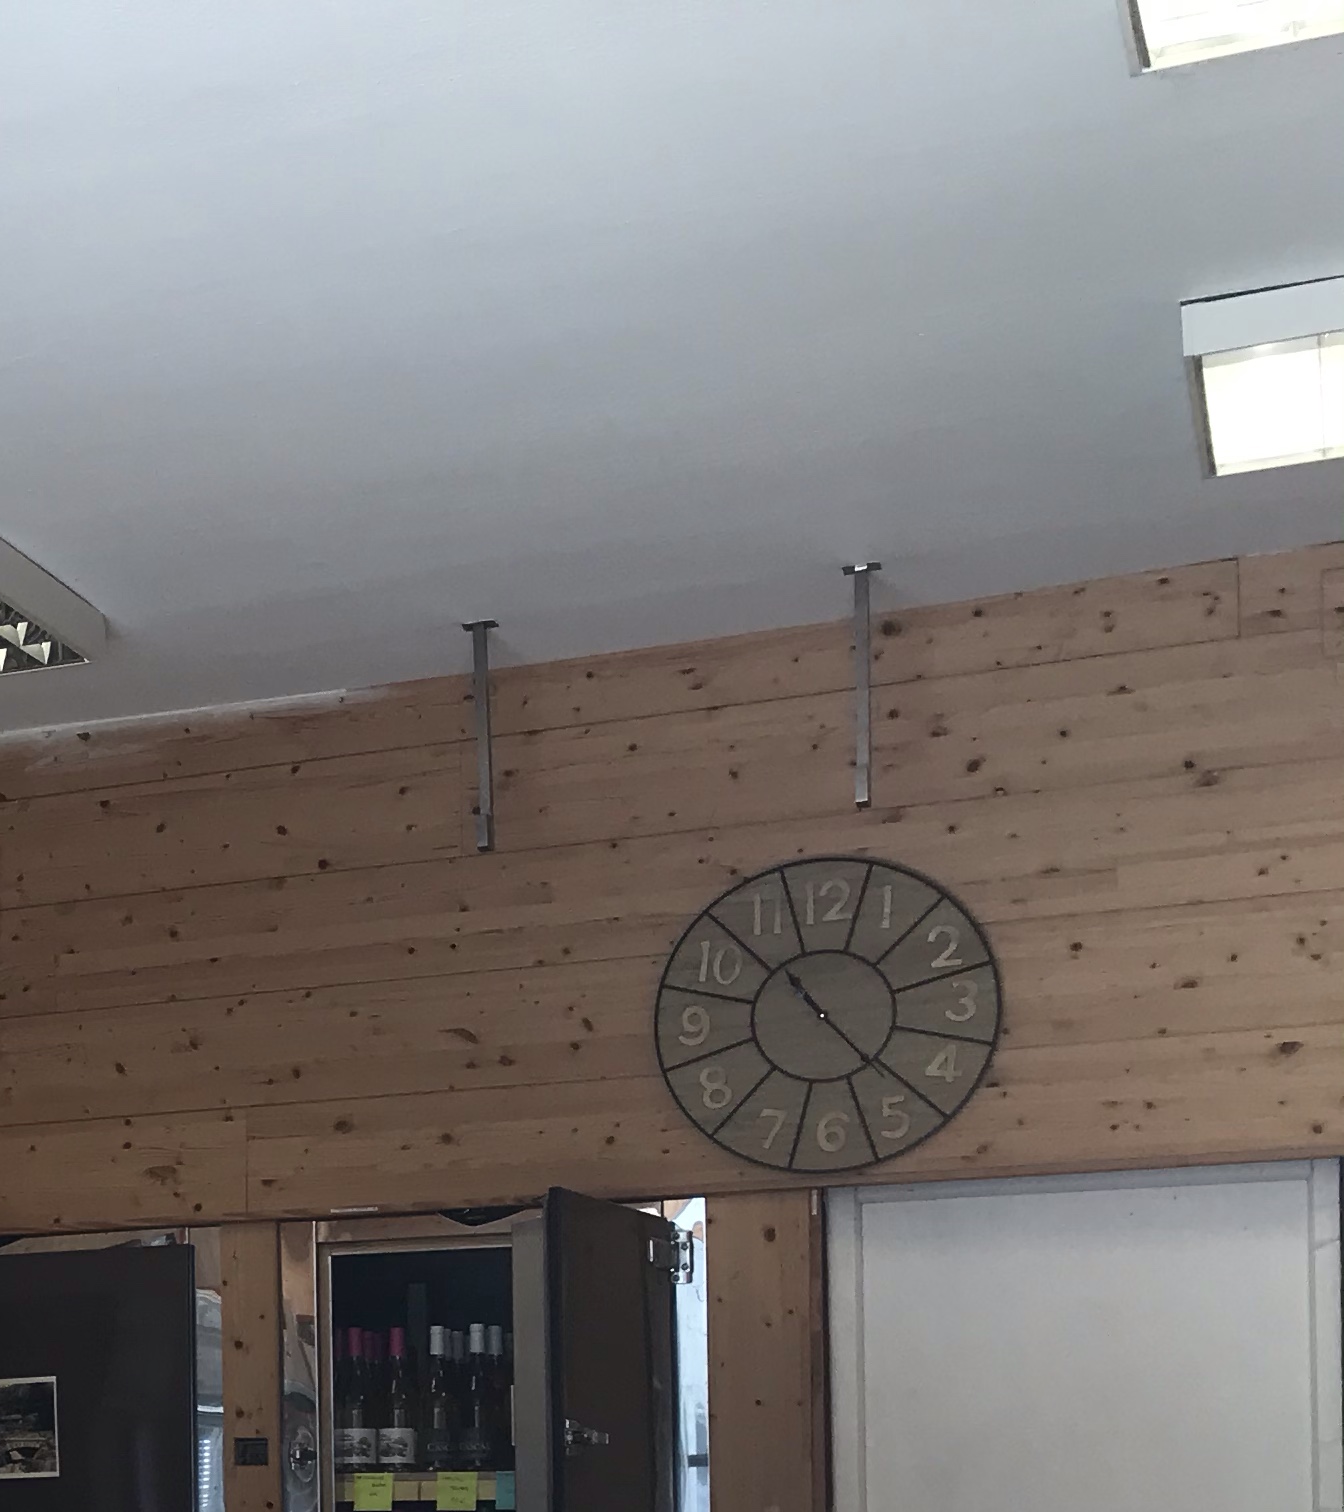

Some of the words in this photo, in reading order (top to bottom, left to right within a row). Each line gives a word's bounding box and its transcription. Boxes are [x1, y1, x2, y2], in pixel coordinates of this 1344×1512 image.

[752, 892, 783, 936] 11
[805, 877, 854, 926] 12
[879, 884, 893, 930] 1
[698, 940, 744, 986] 10
[926, 924, 964, 969] 2
[944, 978, 979, 1022] 3
[678, 1005, 711, 1047] 9
[924, 1044, 963, 1084] 4
[698, 1065, 733, 1110] 8
[759, 1108, 787, 1150] 7
[816, 1110, 851, 1153] 6
[880, 1095, 910, 1140] 5
